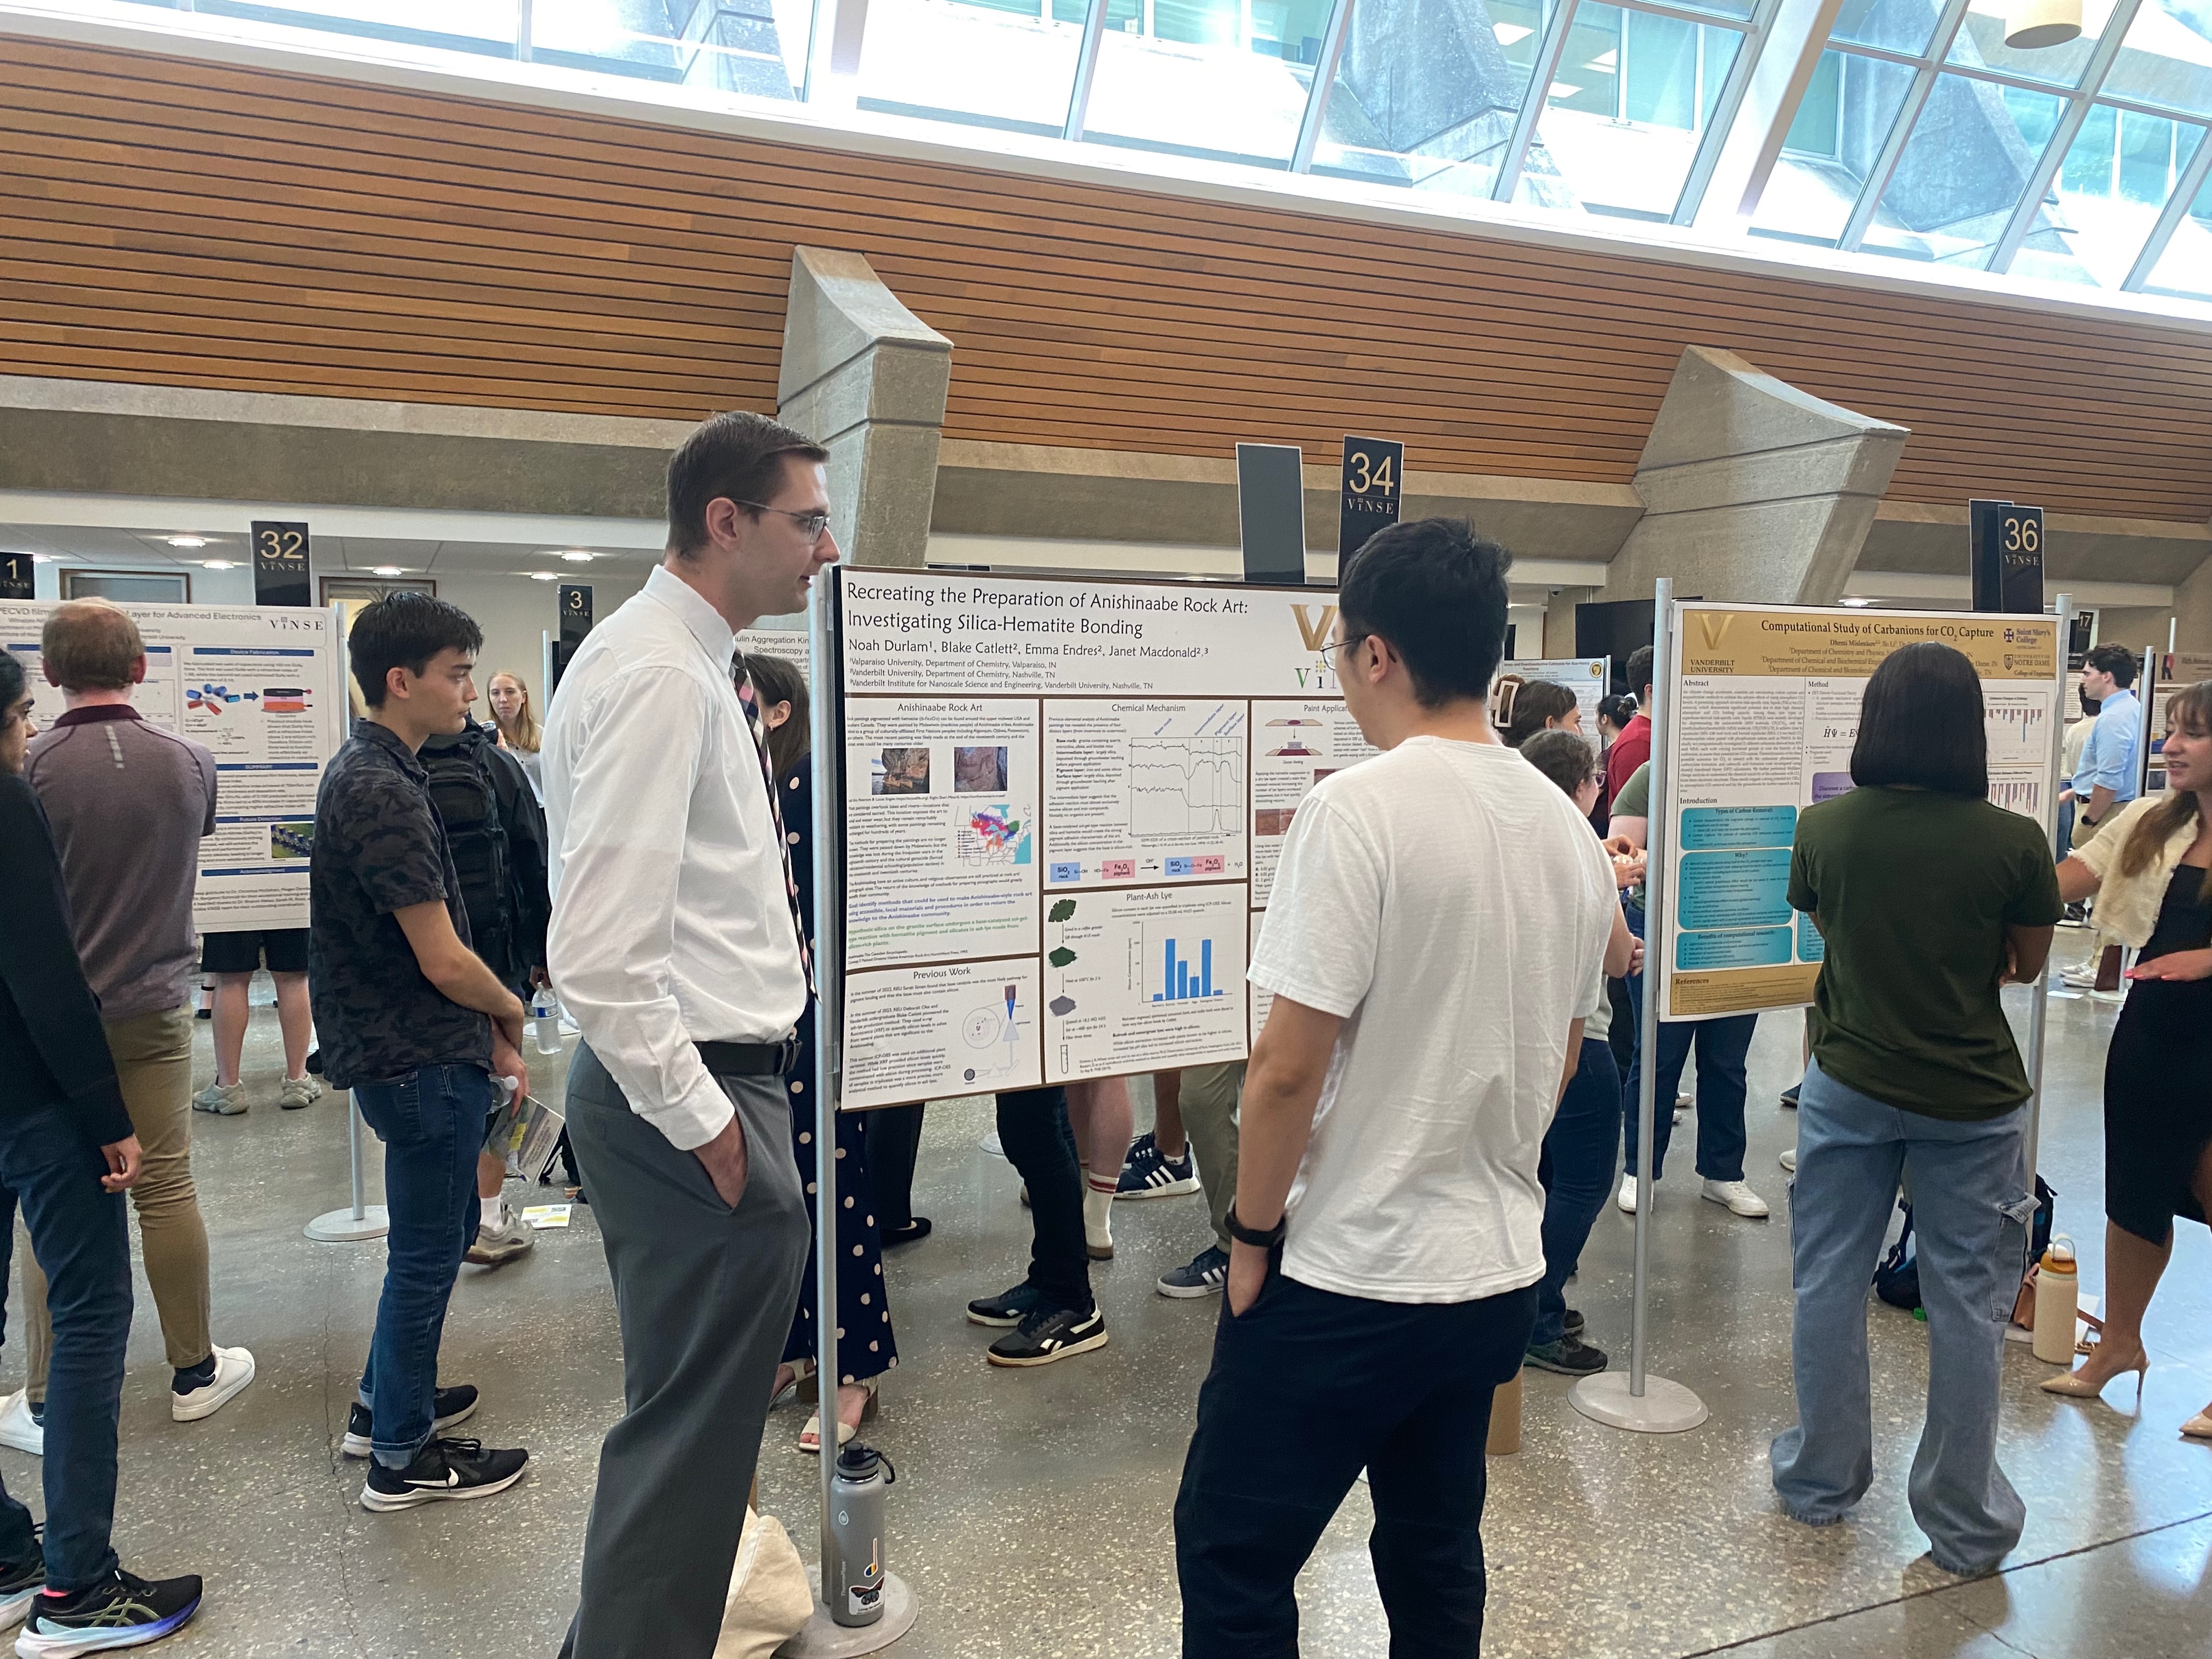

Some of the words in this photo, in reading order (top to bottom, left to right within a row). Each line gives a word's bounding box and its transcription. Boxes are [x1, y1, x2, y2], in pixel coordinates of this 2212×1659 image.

[1349, 452, 1394, 496] 34
[2005, 518, 2038, 551] 36
[261, 531, 303, 560] 32
[570, 591, 583, 609] 3
[848, 583, 934, 606] Recreating
[940, 587, 966, 603] the
[973, 589, 1063, 608] Preparation
[1070, 592, 1086, 607] of
[1091, 594, 1178, 611] Anishinaabe
[1184, 597, 1217, 612] Rock
[1222, 599, 1248, 613] Art:
[213, 612, 261, 620] Electronics
[2079, 614, 2092, 627] 17
[849, 611, 952, 633] Investigating
[958, 614, 1074, 632] Silica-Hematite
[1081, 619, 1143, 639] Bonding
[1762, 620, 1831, 634] Computational
[1833, 623, 1860, 636] Study
[1863, 624, 1871, 634] of
[1874, 624, 1924, 635] Carbanions
[1927, 625, 1939, 636] for
[1959, 627, 1994, 640] Capture
[2016, 628, 2032, 637] Saint
[2033, 629, 2051, 637] Mary's
[752, 636, 795, 645] Aggregation
[754, 646, 803, 656] Spectroscopy
[849, 639, 879, 651] Noah
[942, 641, 972, 653] Blake
[1026, 644, 1058, 654] Emma
[1109, 646, 1136, 656] Janet
[888, 659, 923, 667] University,
[926, 659, 965, 668] Department
[976, 660, 1010, 669] Chemistry,
[888, 669, 923, 678] University,
[926, 670, 965, 678] Department
[977, 670, 1010, 679] Chemistry,
[1005, 681, 1043, 690] Engineering,
[1127, 893, 1159, 901] Plant-Ash
[1161, 891, 1172, 900] Lye
[913, 970, 946, 979] Previous
[949, 967, 970, 975] Work
